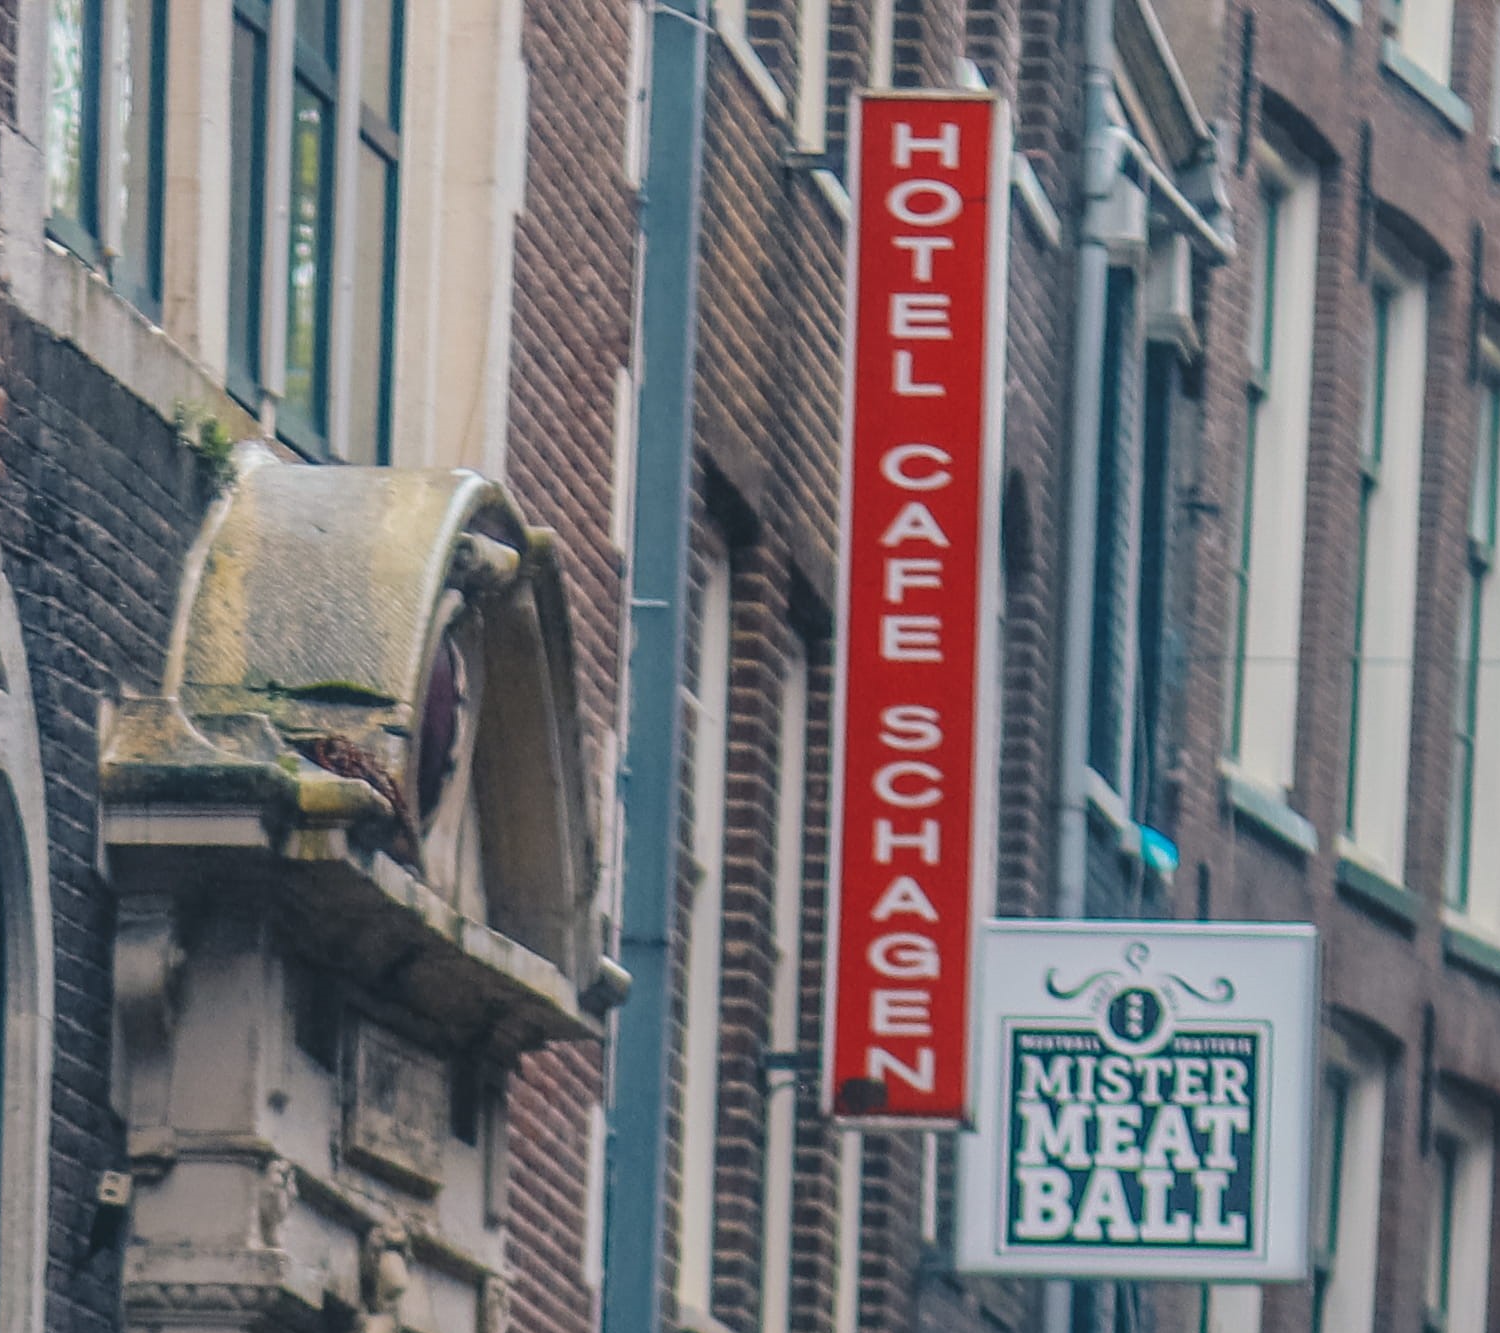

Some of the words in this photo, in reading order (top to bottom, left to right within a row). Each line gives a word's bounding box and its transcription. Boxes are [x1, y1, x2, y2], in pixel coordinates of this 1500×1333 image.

[884, 123, 962, 397] HOTEL
[879, 444, 953, 662] CAFE
[866, 705, 943, 1093] SCHAGEN
[1017, 1055, 1250, 1104] MISTER
[1017, 1105, 1251, 1170] MEAT
[1015, 1168, 1247, 1244] BALL
